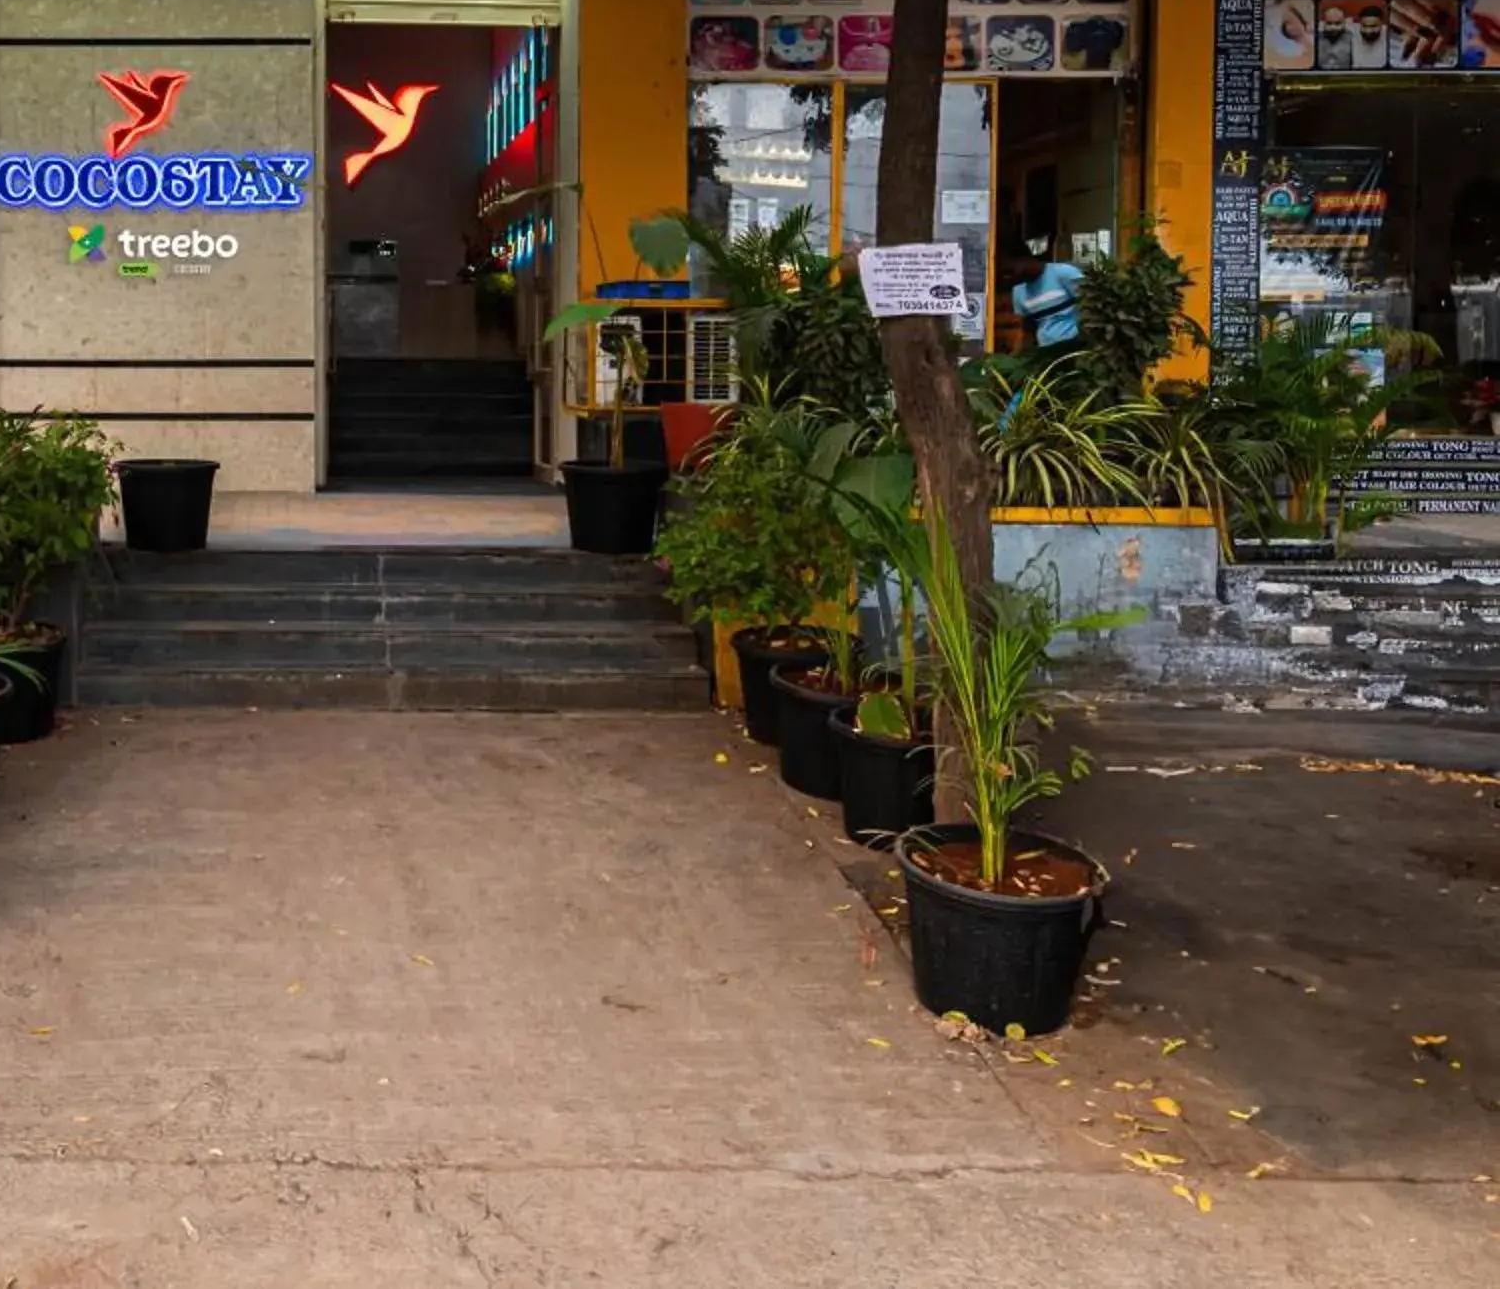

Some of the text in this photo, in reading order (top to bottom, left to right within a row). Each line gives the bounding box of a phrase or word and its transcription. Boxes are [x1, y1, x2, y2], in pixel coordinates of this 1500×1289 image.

[1217, 212, 1249, 224] AQUA
[117, 229, 239, 258] treebo
[1431, 441, 1468, 451] TONG
[1389, 480, 1417, 489] HAIR
[1419, 480, 1466, 489] COLOUR
[1419, 500, 1479, 511] PERMANENT
[1389, 561, 1438, 574] TONG
